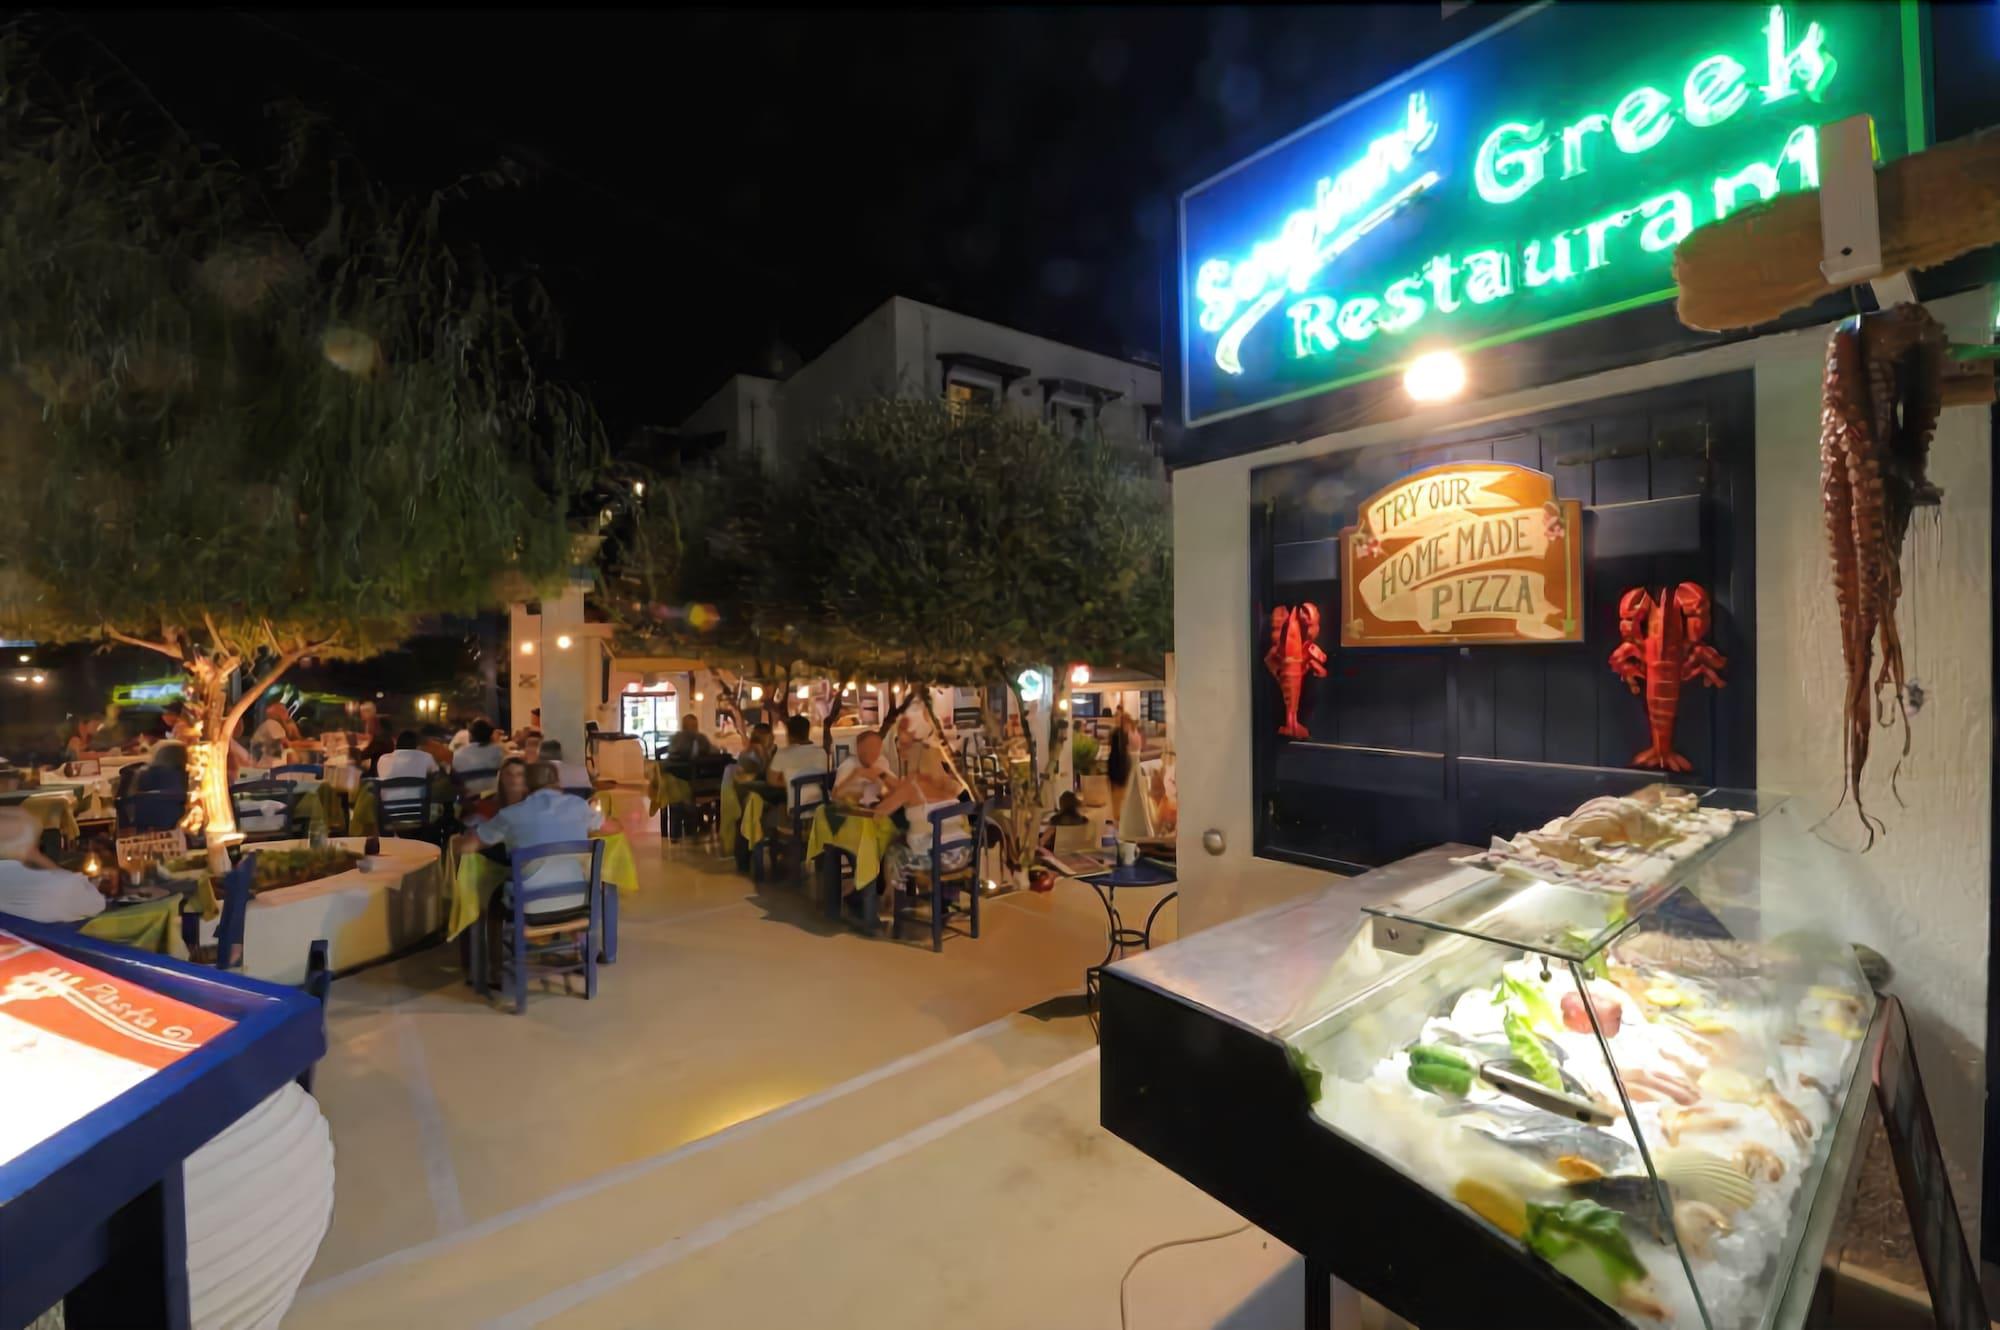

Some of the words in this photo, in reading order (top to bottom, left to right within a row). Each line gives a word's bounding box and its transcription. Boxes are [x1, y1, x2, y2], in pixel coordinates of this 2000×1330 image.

[1474, 4, 1838, 205] Greek
[1376, 485, 1424, 534] TRY
[1428, 478, 1472, 508] OUR
[1380, 533, 1450, 603] HOME
[1455, 516, 1533, 565] MADE
[1431, 575, 1534, 620] PIZZA
